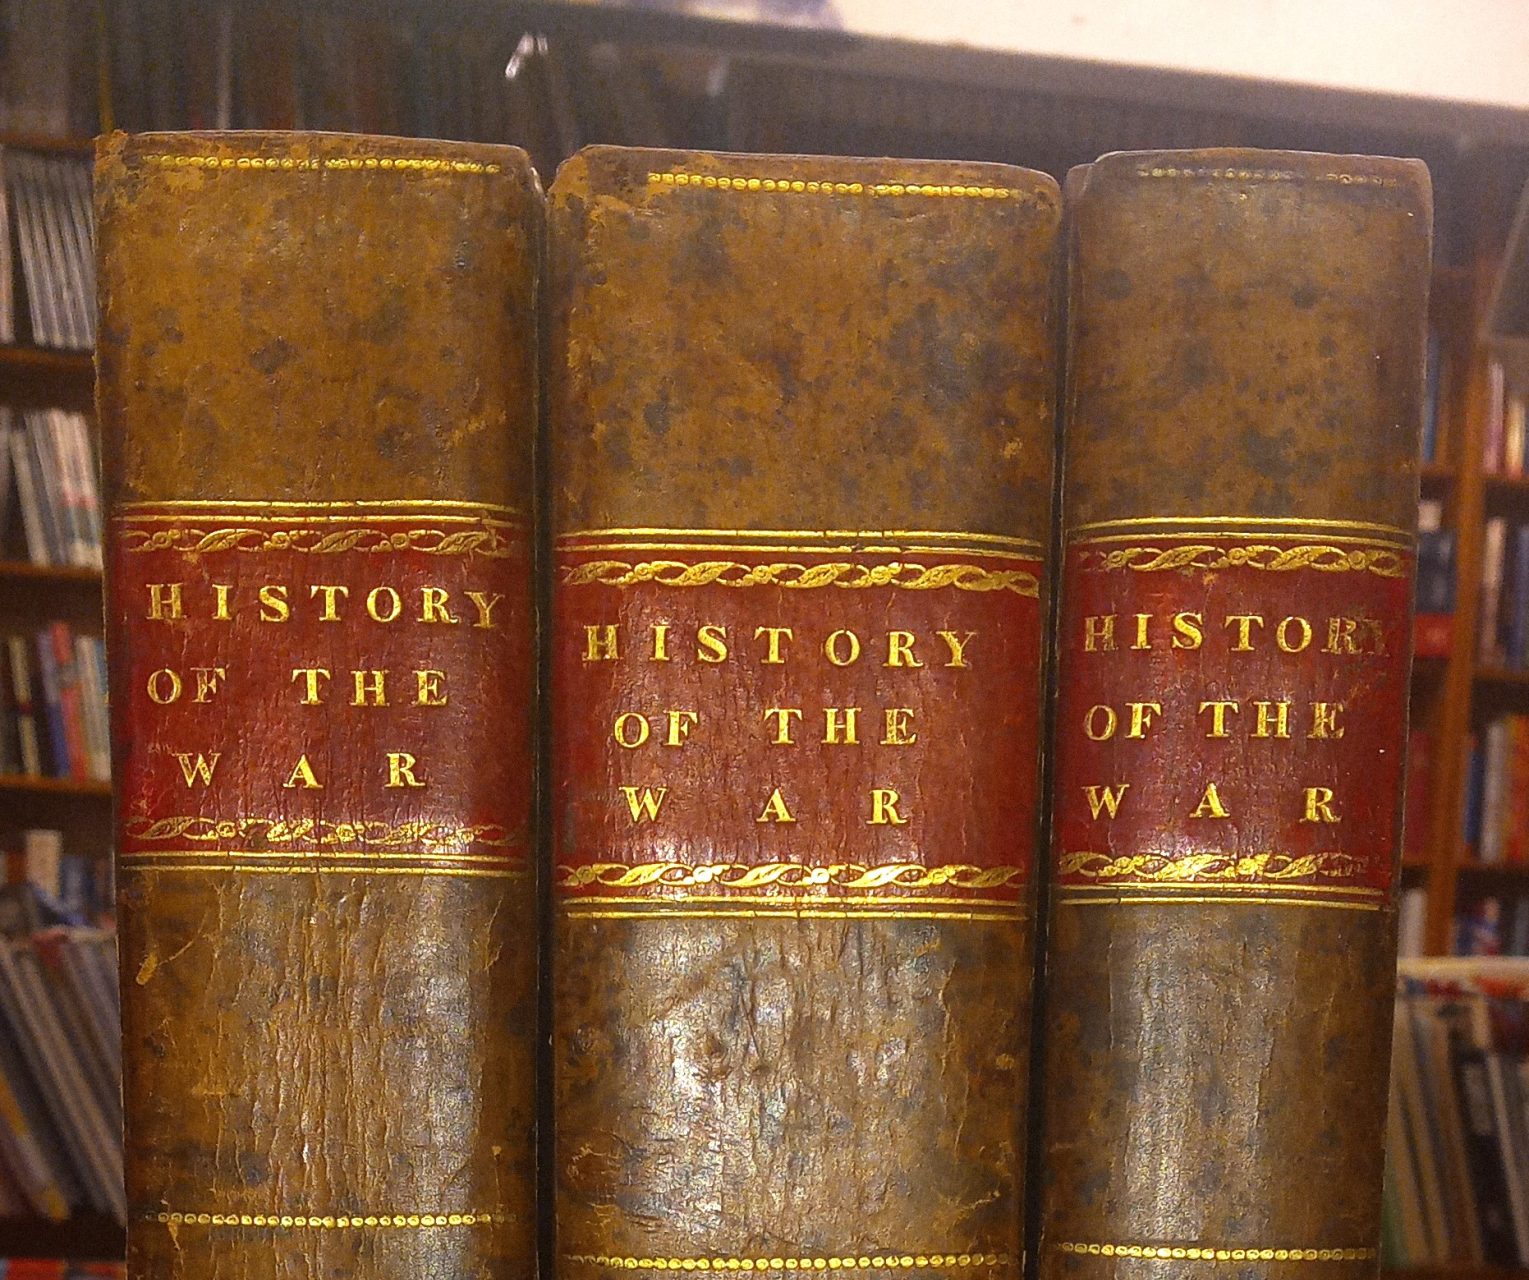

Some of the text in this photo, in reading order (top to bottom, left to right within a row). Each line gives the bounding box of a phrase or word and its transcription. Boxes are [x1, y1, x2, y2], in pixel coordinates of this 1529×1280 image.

[146, 583, 505, 628] HISTORY
[582, 622, 979, 667] HISTORY
[147, 667, 449, 707] OF THE
[613, 707, 918, 749] OF THE
[1083, 700, 1345, 741] OF THE
[173, 751, 426, 790] WAR
[618, 785, 908, 825] WAR
[1081, 782, 1342, 824] WAR
